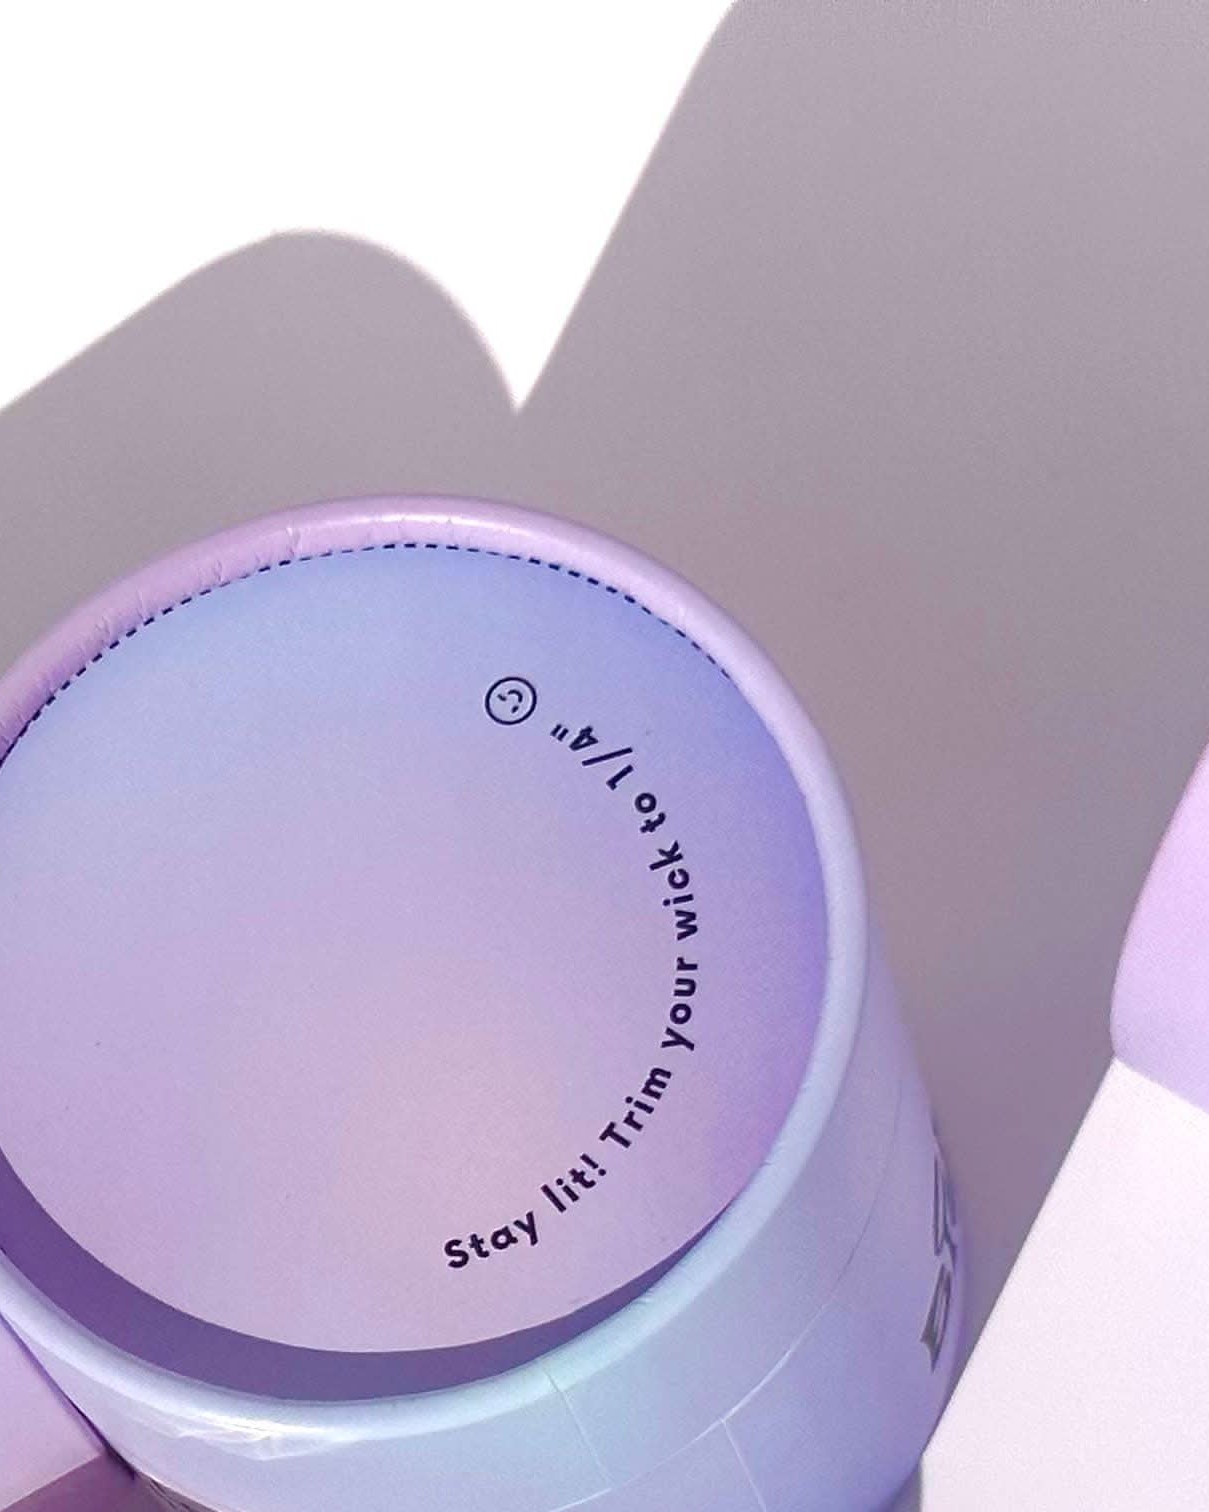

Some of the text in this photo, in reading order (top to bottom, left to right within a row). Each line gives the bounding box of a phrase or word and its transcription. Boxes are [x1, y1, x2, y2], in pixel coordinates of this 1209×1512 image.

[444, 723, 699, 1269] Stay lit! Trim your wick to 1/4"
